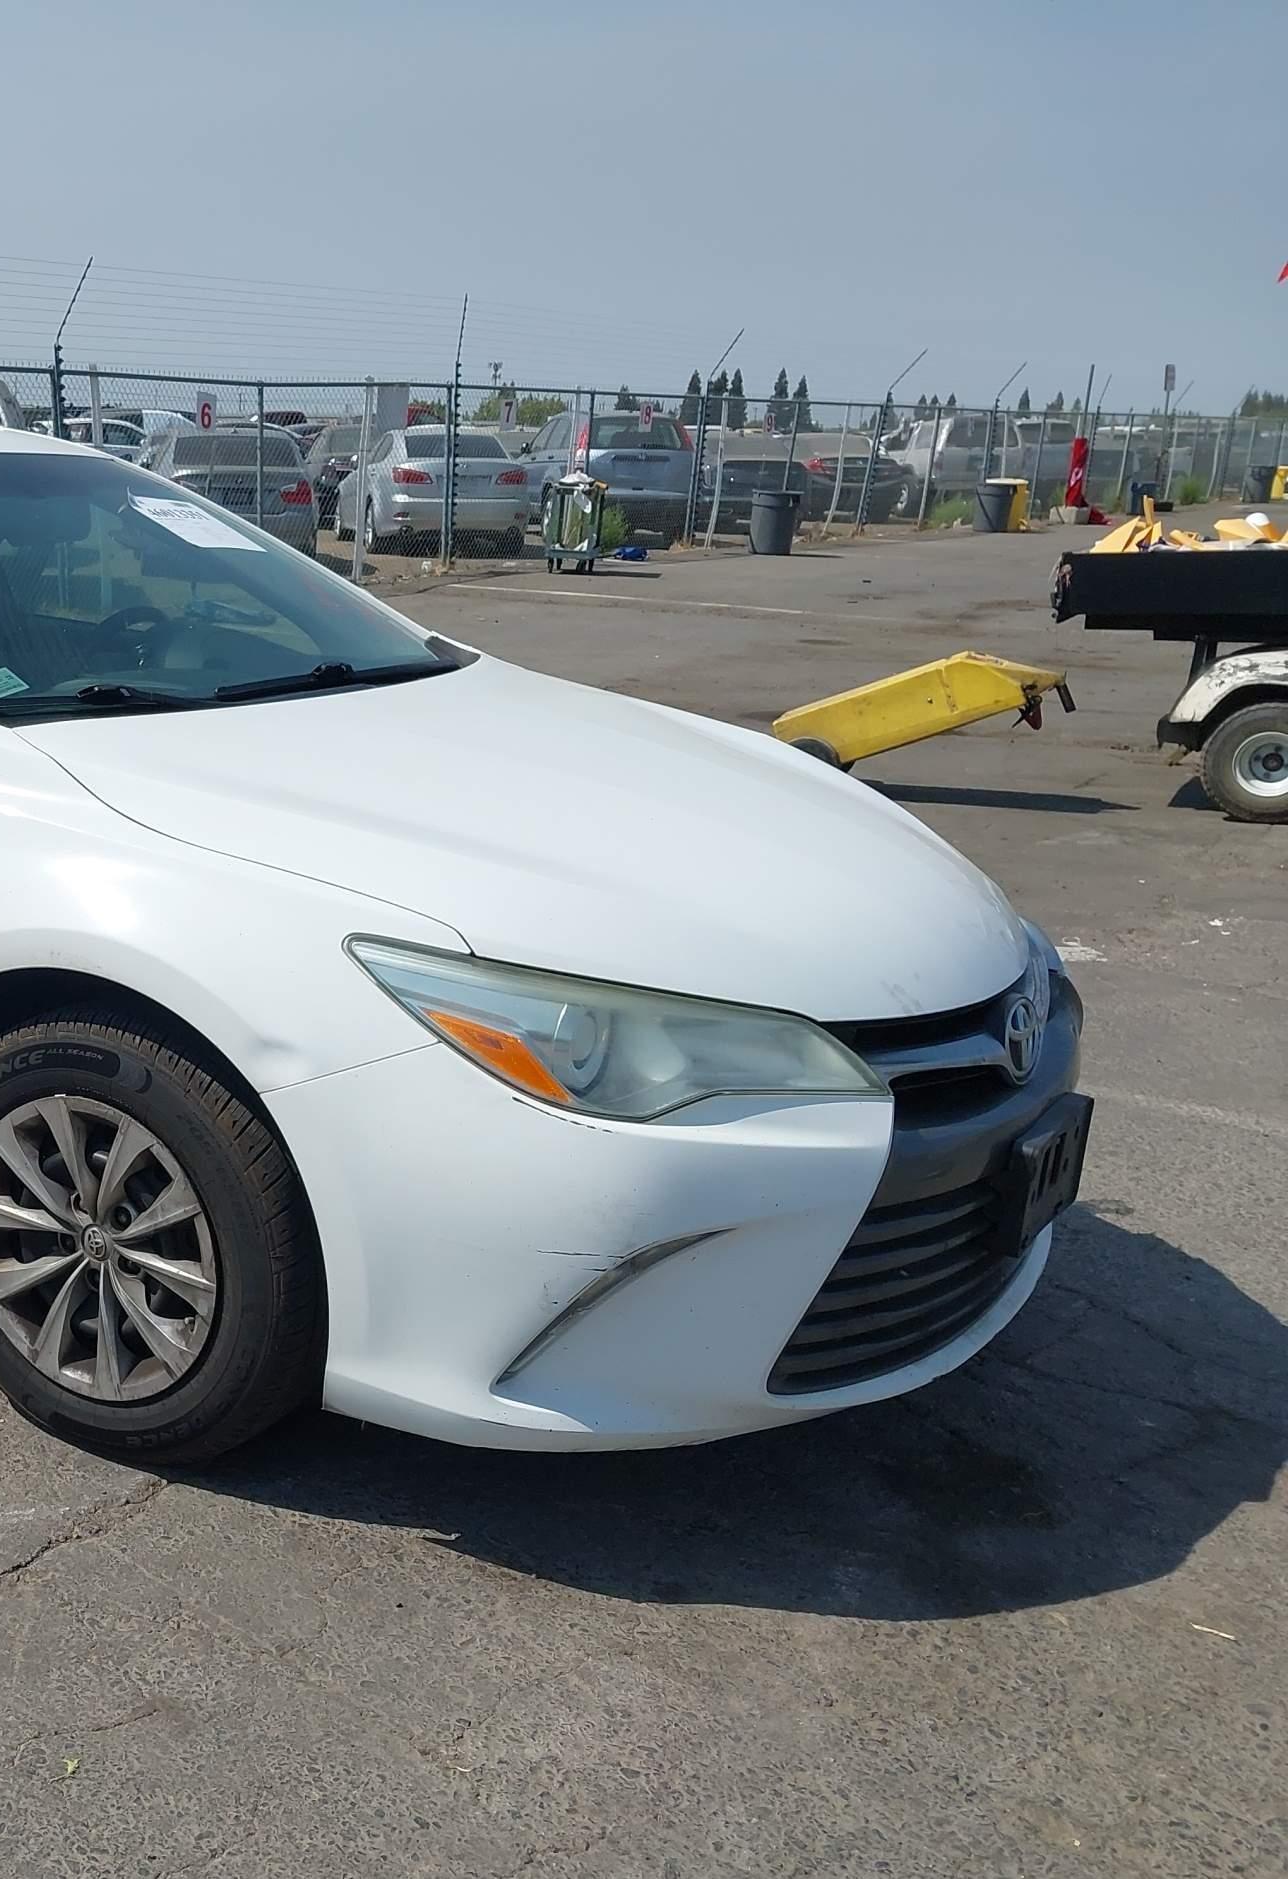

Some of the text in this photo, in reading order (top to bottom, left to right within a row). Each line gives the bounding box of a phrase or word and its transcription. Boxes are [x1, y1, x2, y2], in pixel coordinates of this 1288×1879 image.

[201, 402, 212, 429] 6
[504, 401, 514, 423] 7
[643, 405, 652, 425] 8
[766, 414, 773, 433] 9
